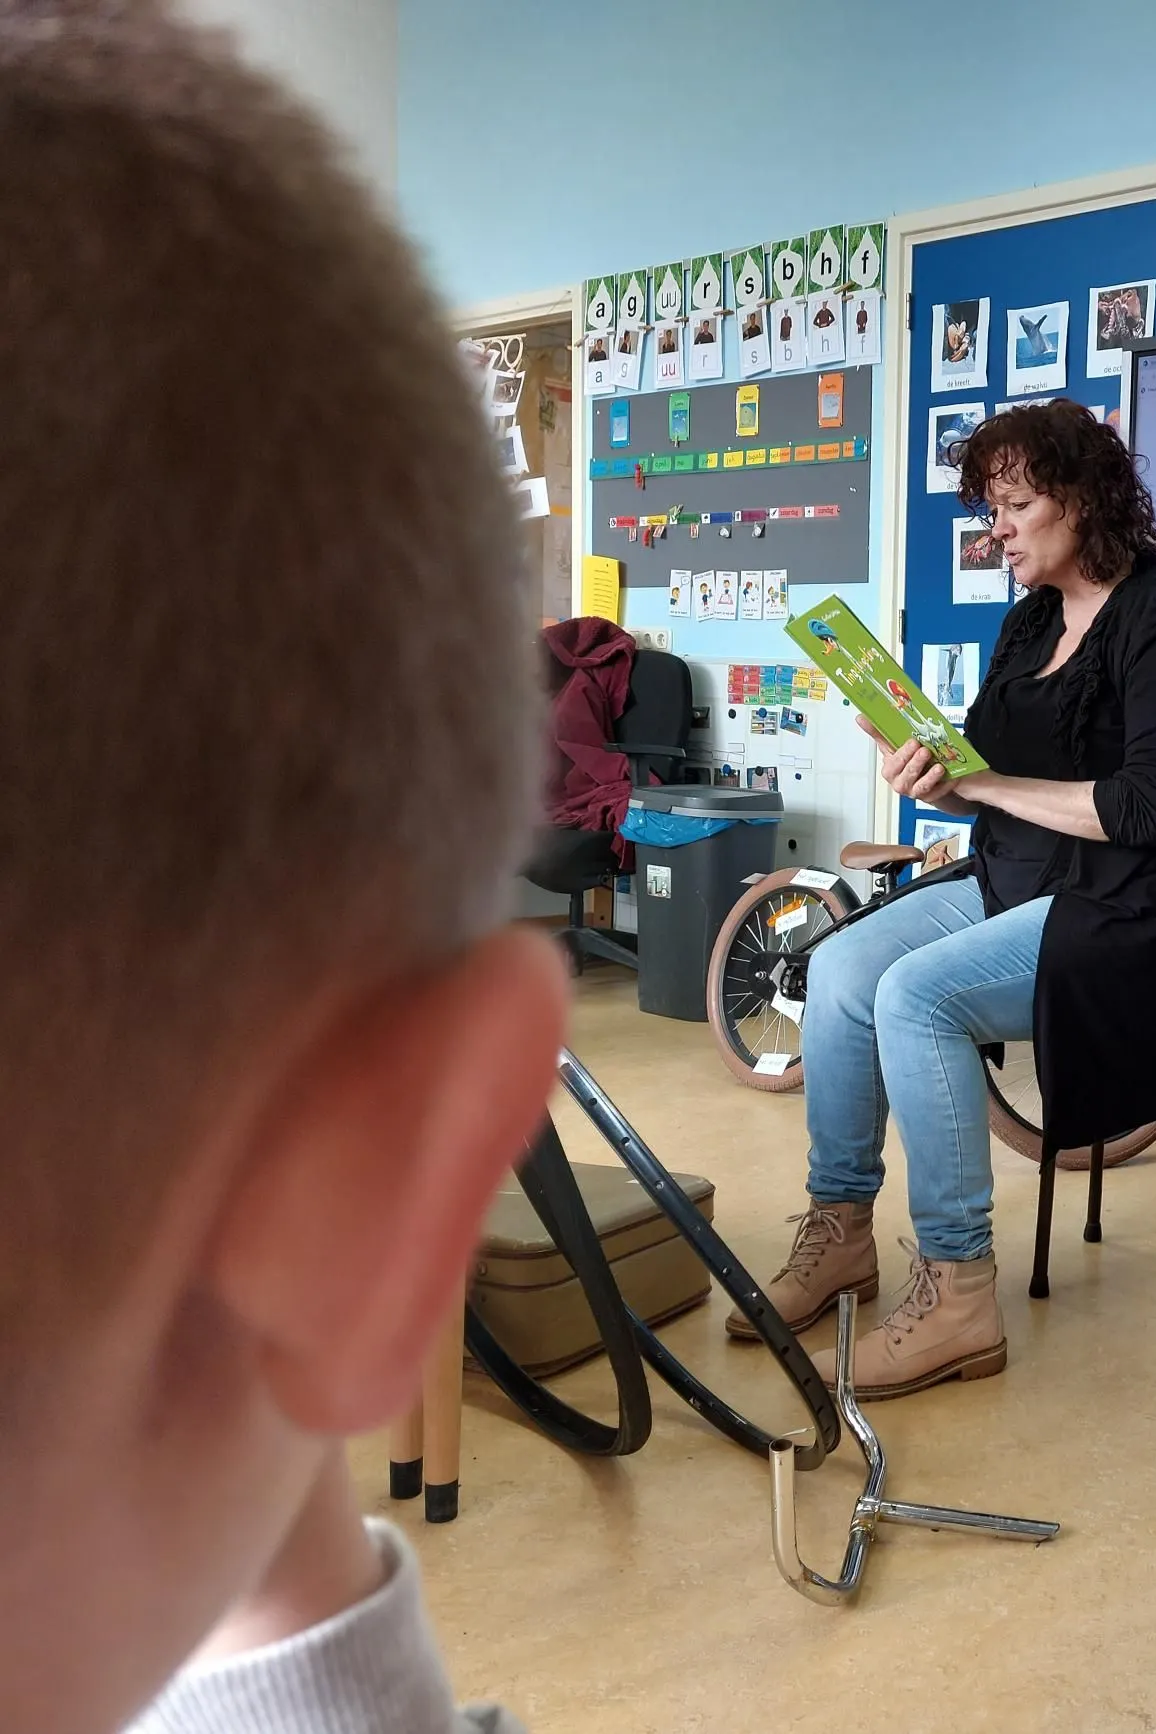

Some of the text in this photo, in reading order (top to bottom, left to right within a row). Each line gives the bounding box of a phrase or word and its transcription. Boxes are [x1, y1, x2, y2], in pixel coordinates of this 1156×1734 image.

[782, 258, 794, 281] b
[820, 252, 832, 276] h
[862, 250, 870, 275] f
[703, 281, 711, 299] r
[744, 277, 755, 295] s
[628, 295, 637, 318] g
[661, 290, 677, 309] uu
[596, 302, 605, 318] a
[784, 344, 793, 361] b
[821, 335, 830, 353] h
[751, 350, 758, 364] s
[595, 370, 603, 383] a
[620, 362, 628, 378] g
[661, 363, 676, 377] uu
